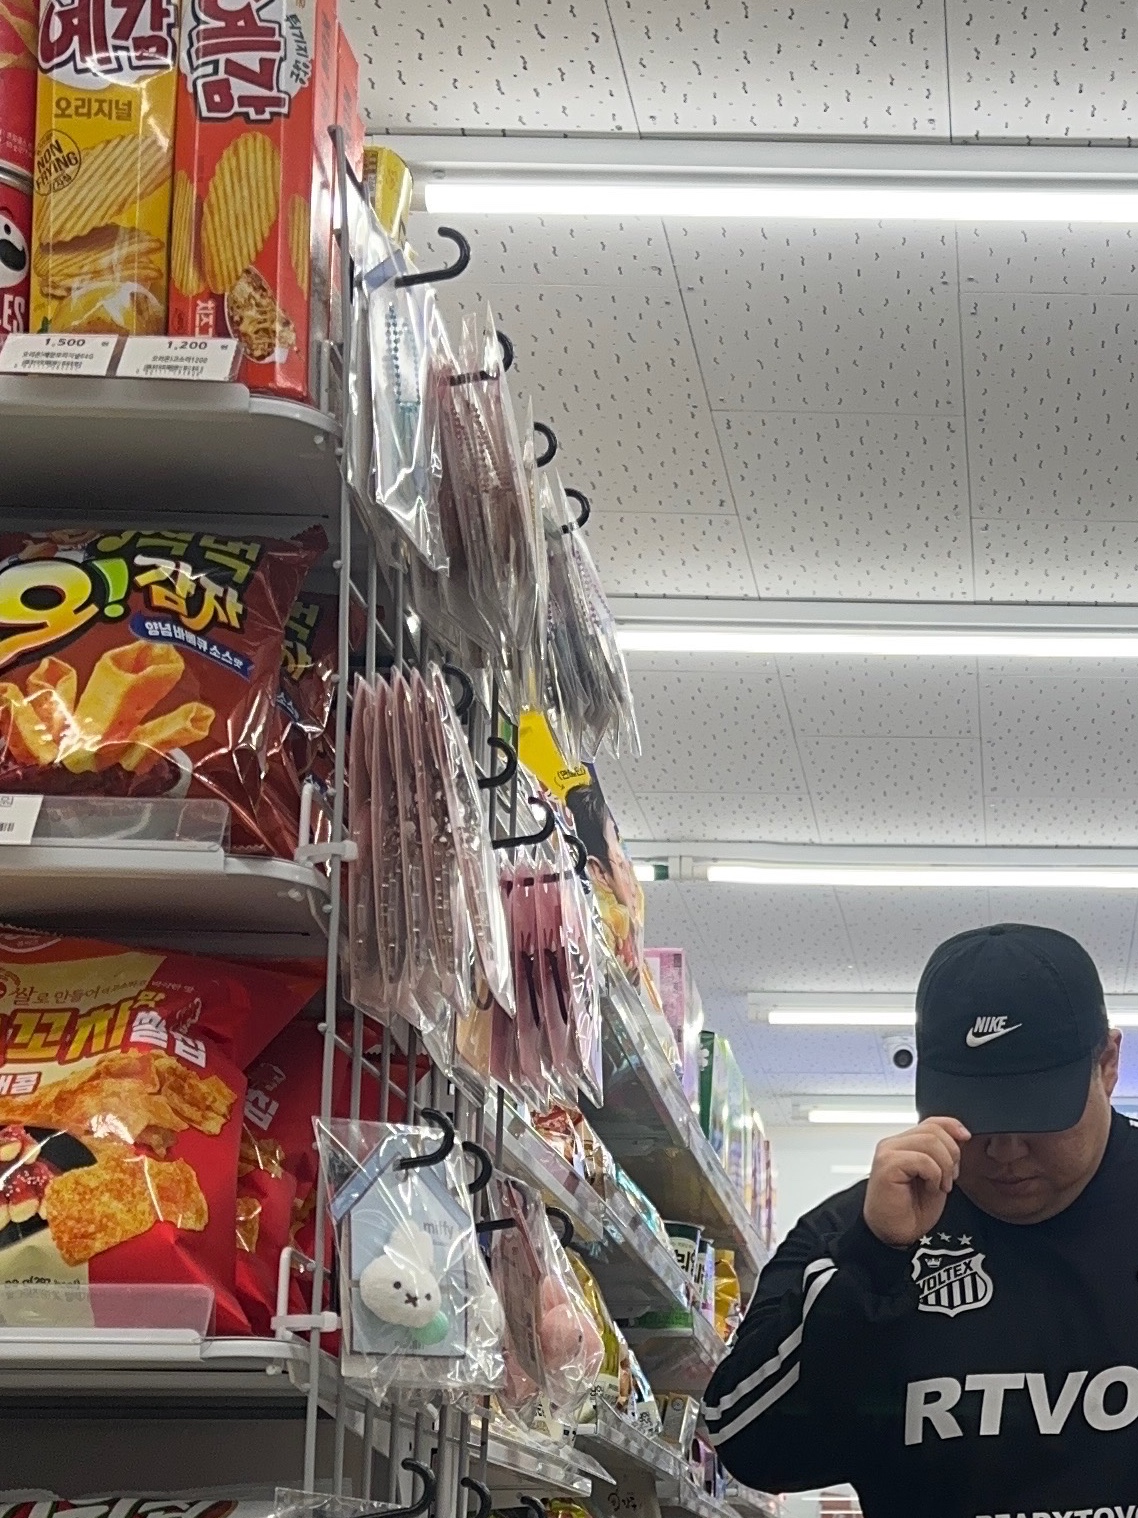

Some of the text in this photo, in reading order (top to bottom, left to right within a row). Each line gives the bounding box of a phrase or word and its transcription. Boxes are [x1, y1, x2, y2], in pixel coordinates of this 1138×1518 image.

[54, 97, 133, 121] 오리지널
[44, 338, 87, 348] 1,500
[167, 340, 208, 350] 1,200
[973, 1016, 1008, 1033] NIKE
[918, 1259, 974, 1295] VOLTEX
